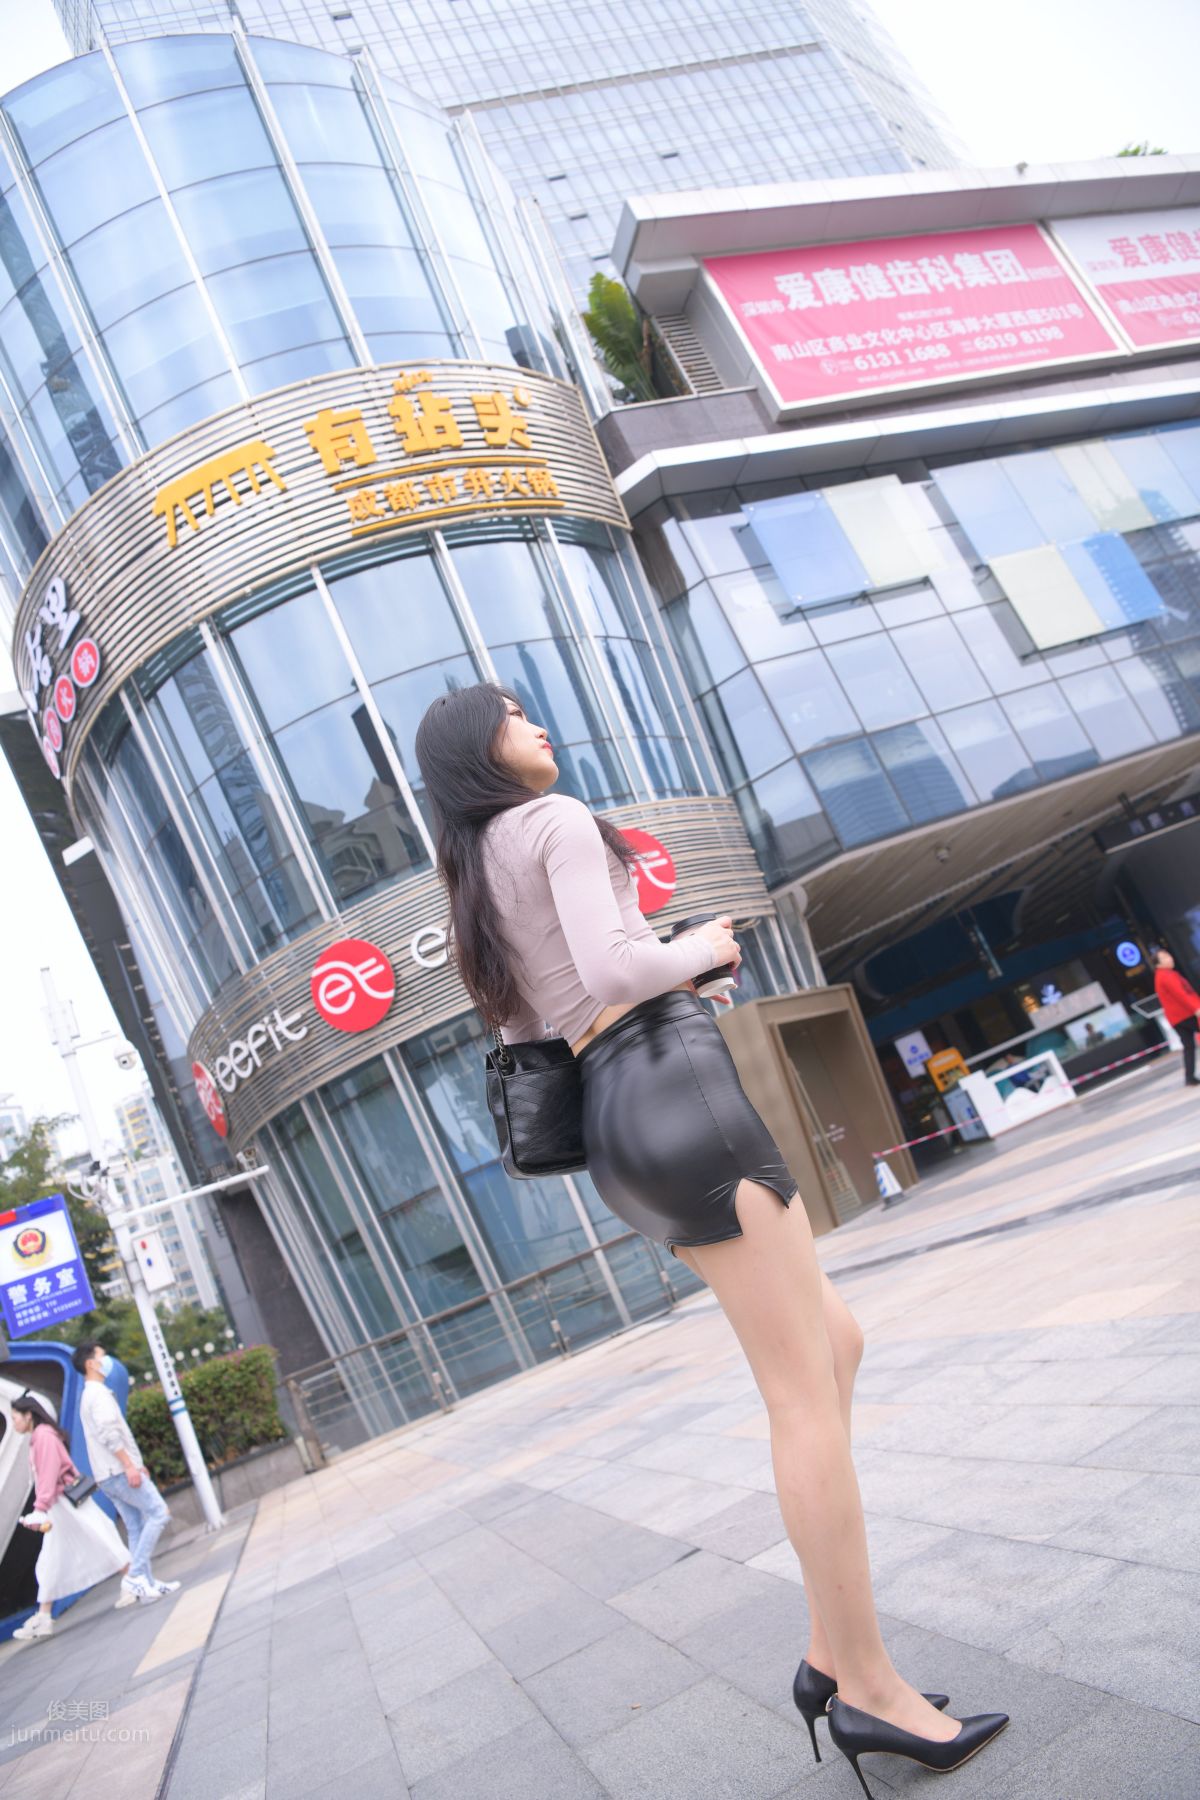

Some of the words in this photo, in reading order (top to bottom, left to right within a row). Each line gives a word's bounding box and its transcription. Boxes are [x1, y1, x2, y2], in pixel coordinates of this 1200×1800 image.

[1107, 230, 1200, 268] 爱康健
[774, 249, 1030, 311] 爱康健齿科集团
[854, 350, 903, 371] 6131
[904, 343, 952, 364] 1688
[974, 331, 1019, 351] 6319
[346, 467, 560, 523] 成都市井火锅
[214, 1009, 308, 1093] eefit
[7, 1267, 77, 1306] 警务室
